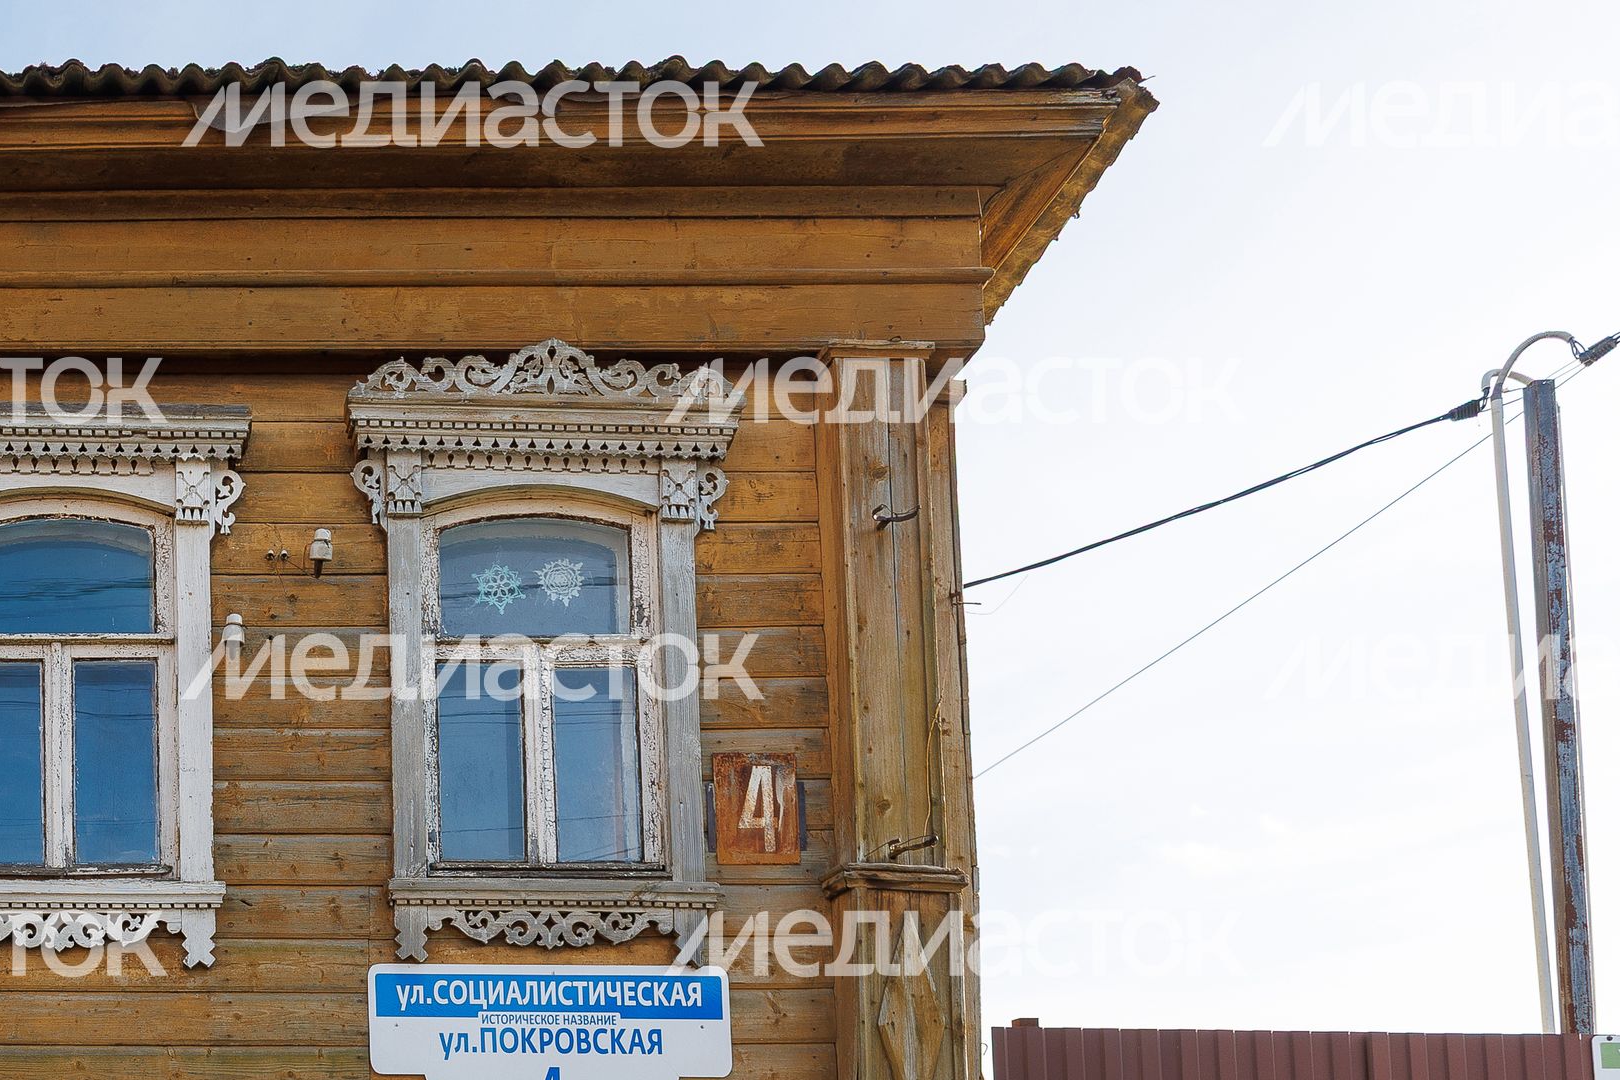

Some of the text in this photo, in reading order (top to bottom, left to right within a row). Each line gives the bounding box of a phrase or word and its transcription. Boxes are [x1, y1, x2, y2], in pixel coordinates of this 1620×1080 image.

[738, 765, 779, 852] 4
[396, 980, 702, 1011] ул.СОЦИАЛИСТИЧЕСКАЯ
[481, 1013, 617, 1026] ИСТОРИЧЕСКОЕ НАЗВАНИЕ
[438, 1027, 663, 1060] ул.ПОКРОВСКАЯ
